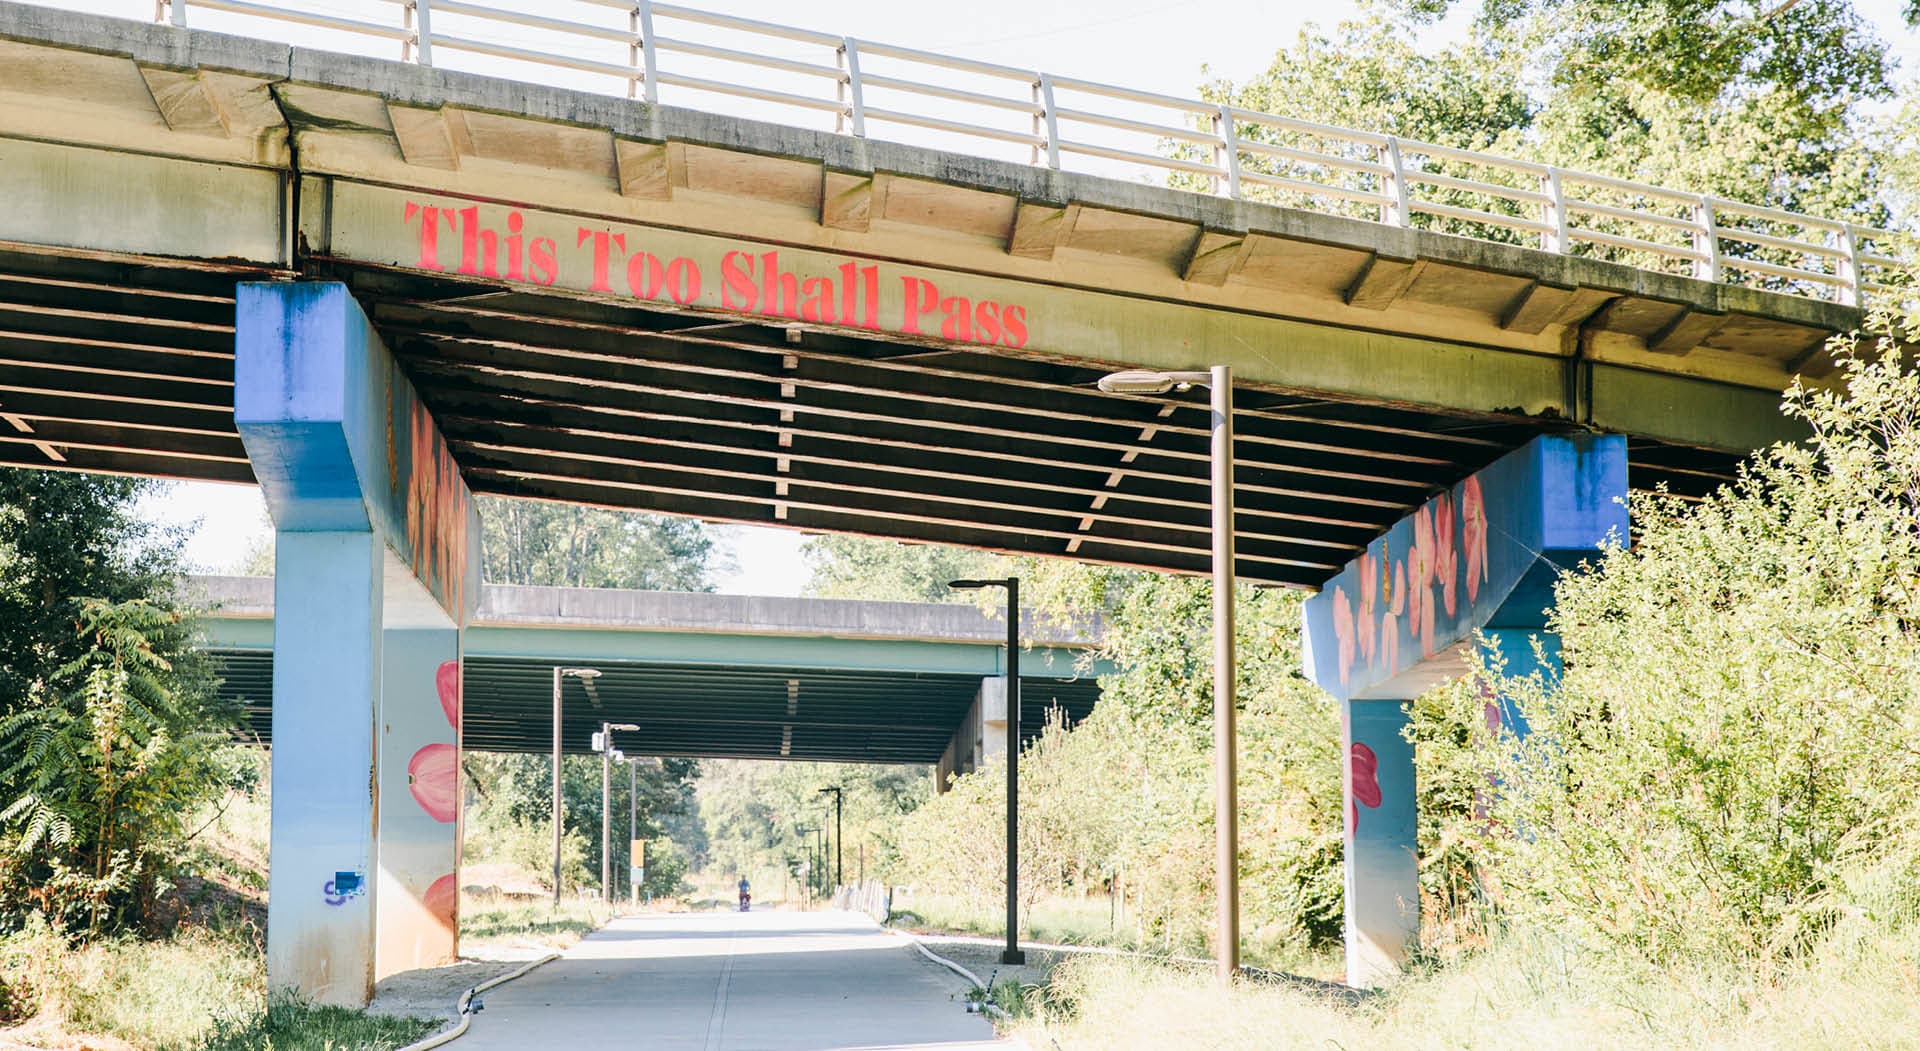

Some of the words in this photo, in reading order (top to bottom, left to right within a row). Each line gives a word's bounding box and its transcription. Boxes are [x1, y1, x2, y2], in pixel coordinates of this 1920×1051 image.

[404, 200, 558, 286] This
[577, 227, 702, 305] Too
[720, 250, 881, 330] Shall
[898, 276, 1029, 348] Pass
